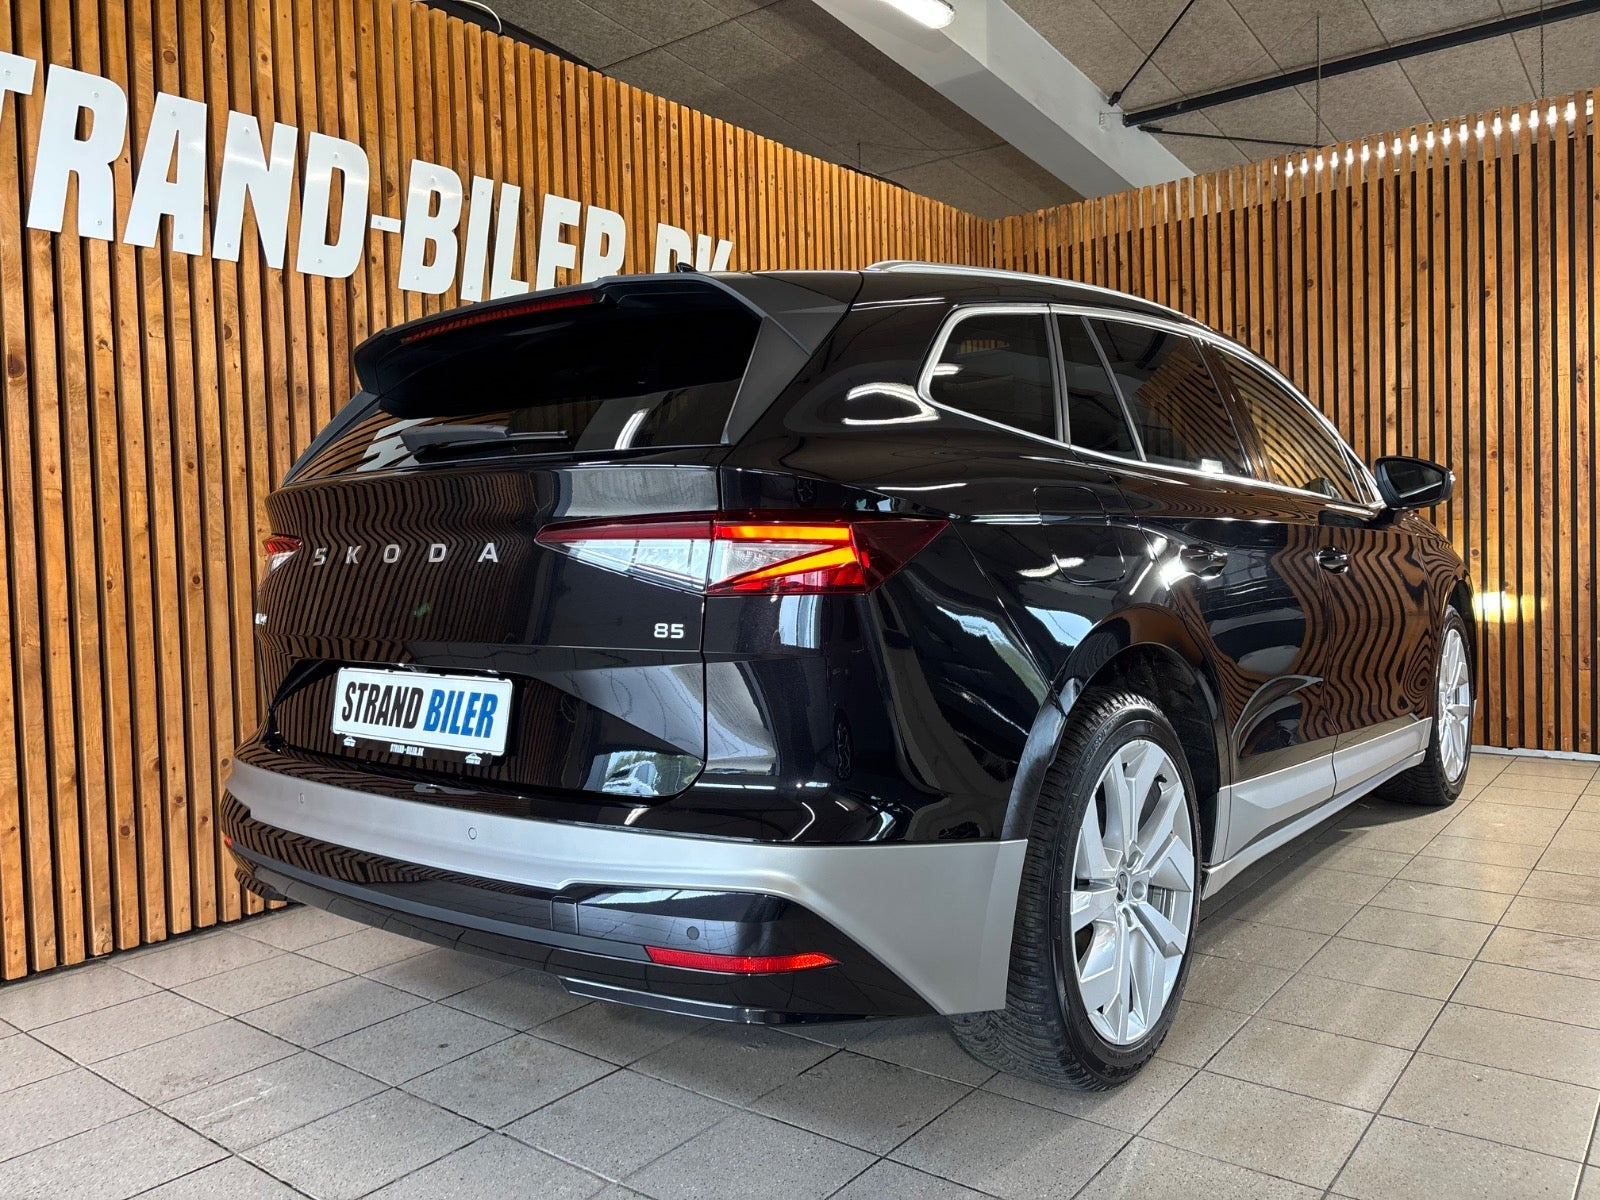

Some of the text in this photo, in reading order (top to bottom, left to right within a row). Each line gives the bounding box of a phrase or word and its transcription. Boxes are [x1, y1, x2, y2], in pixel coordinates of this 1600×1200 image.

[312, 542, 499, 566] SKODA
[653, 622, 685, 639] 85
[341, 680, 498, 739] STRAND BILER
